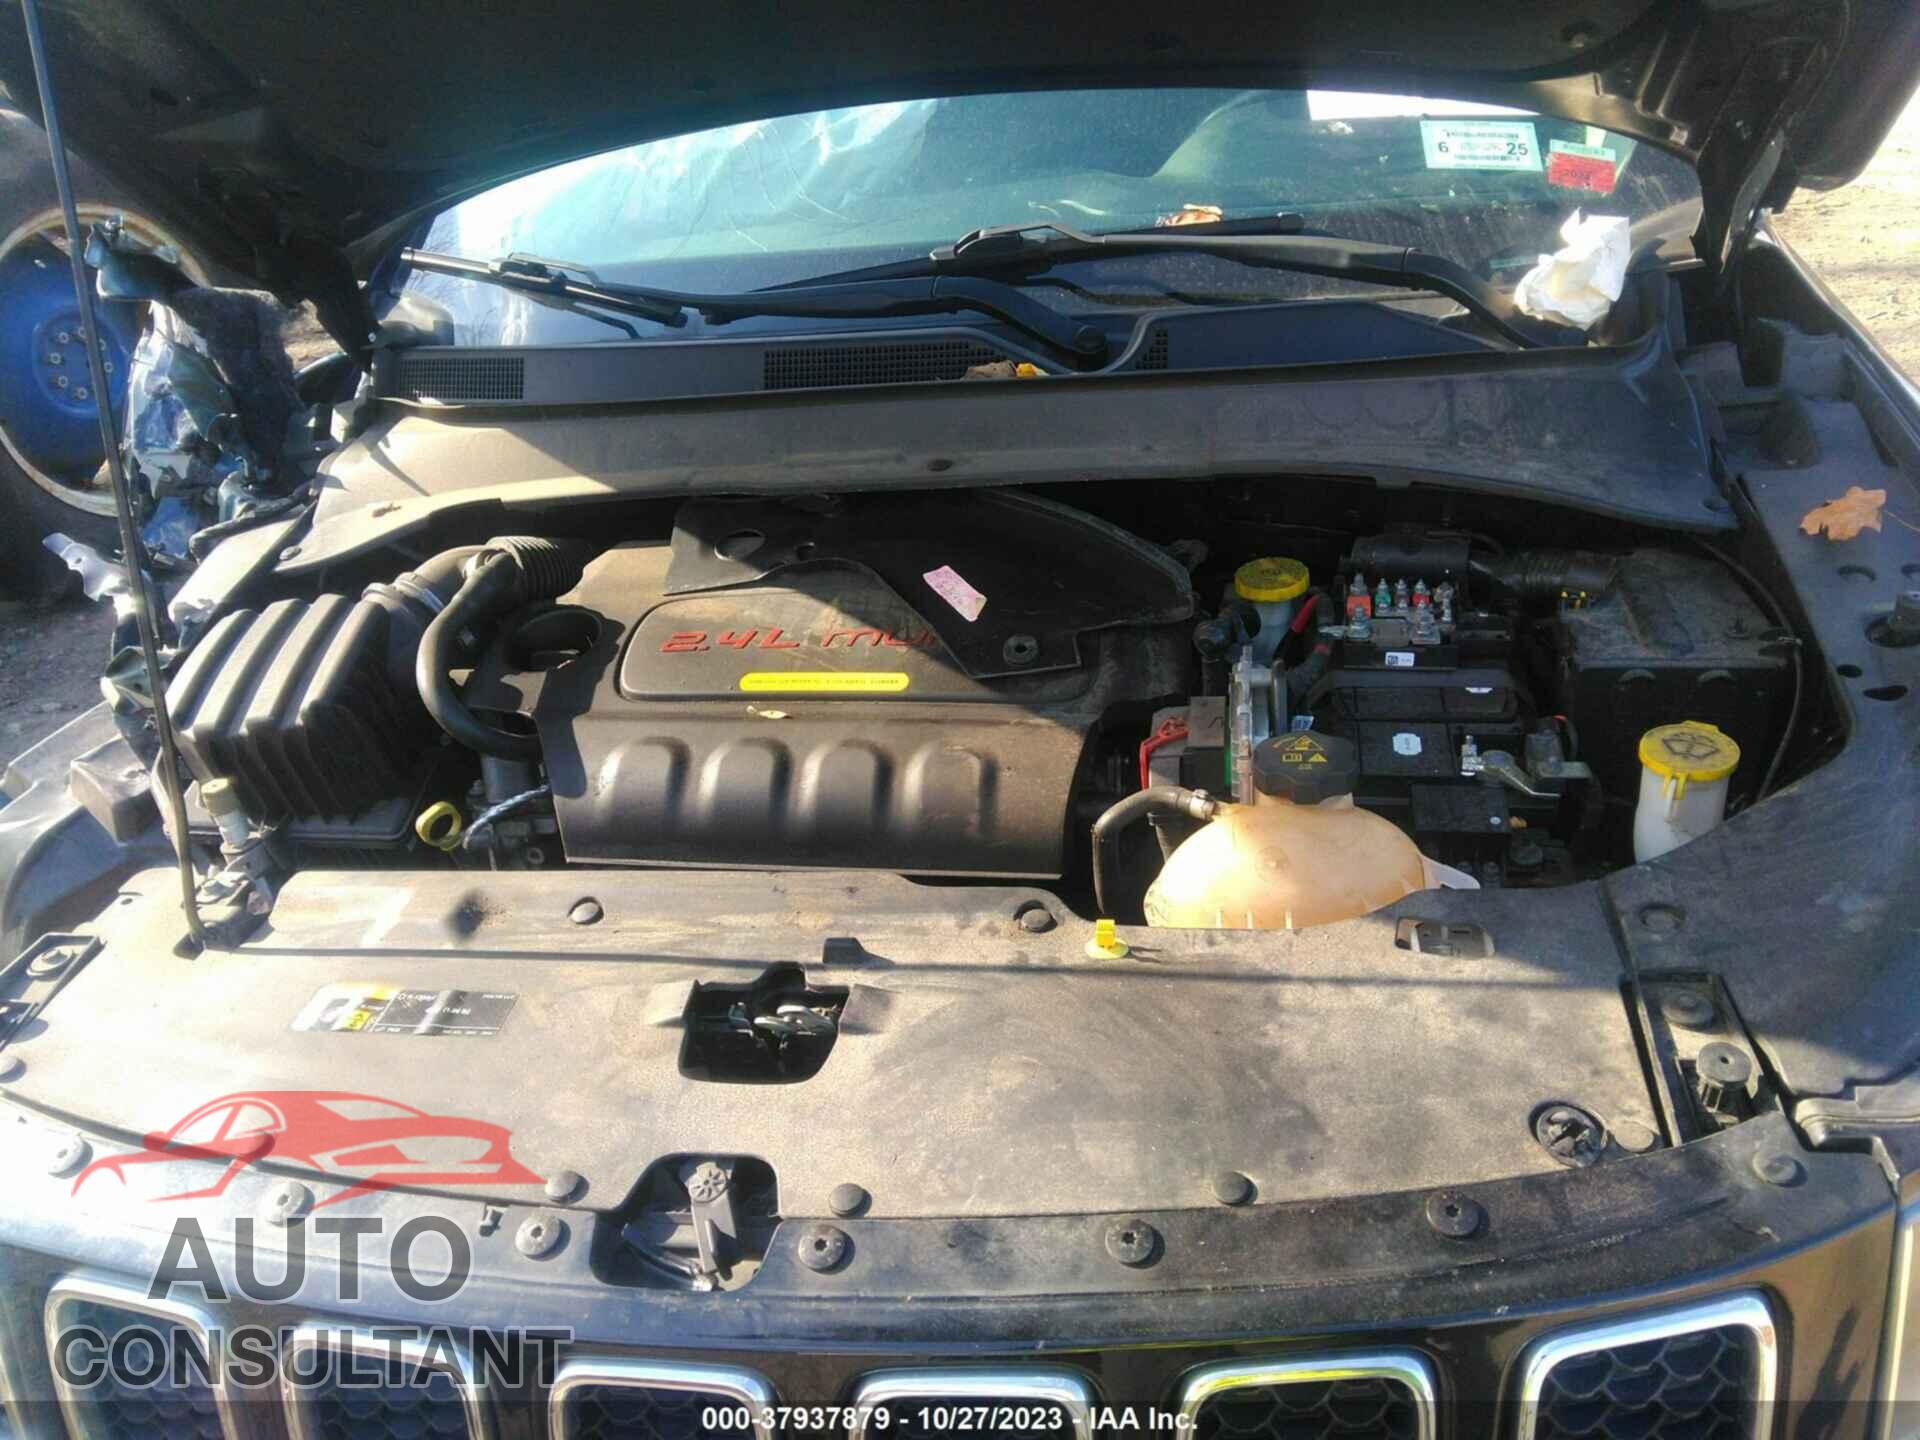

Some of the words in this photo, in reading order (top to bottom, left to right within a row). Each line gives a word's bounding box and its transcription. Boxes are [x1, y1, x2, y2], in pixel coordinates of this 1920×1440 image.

[1438, 142, 1449, 153] 6
[1506, 142, 1529, 156] 25
[659, 627, 800, 653] 2.4L
